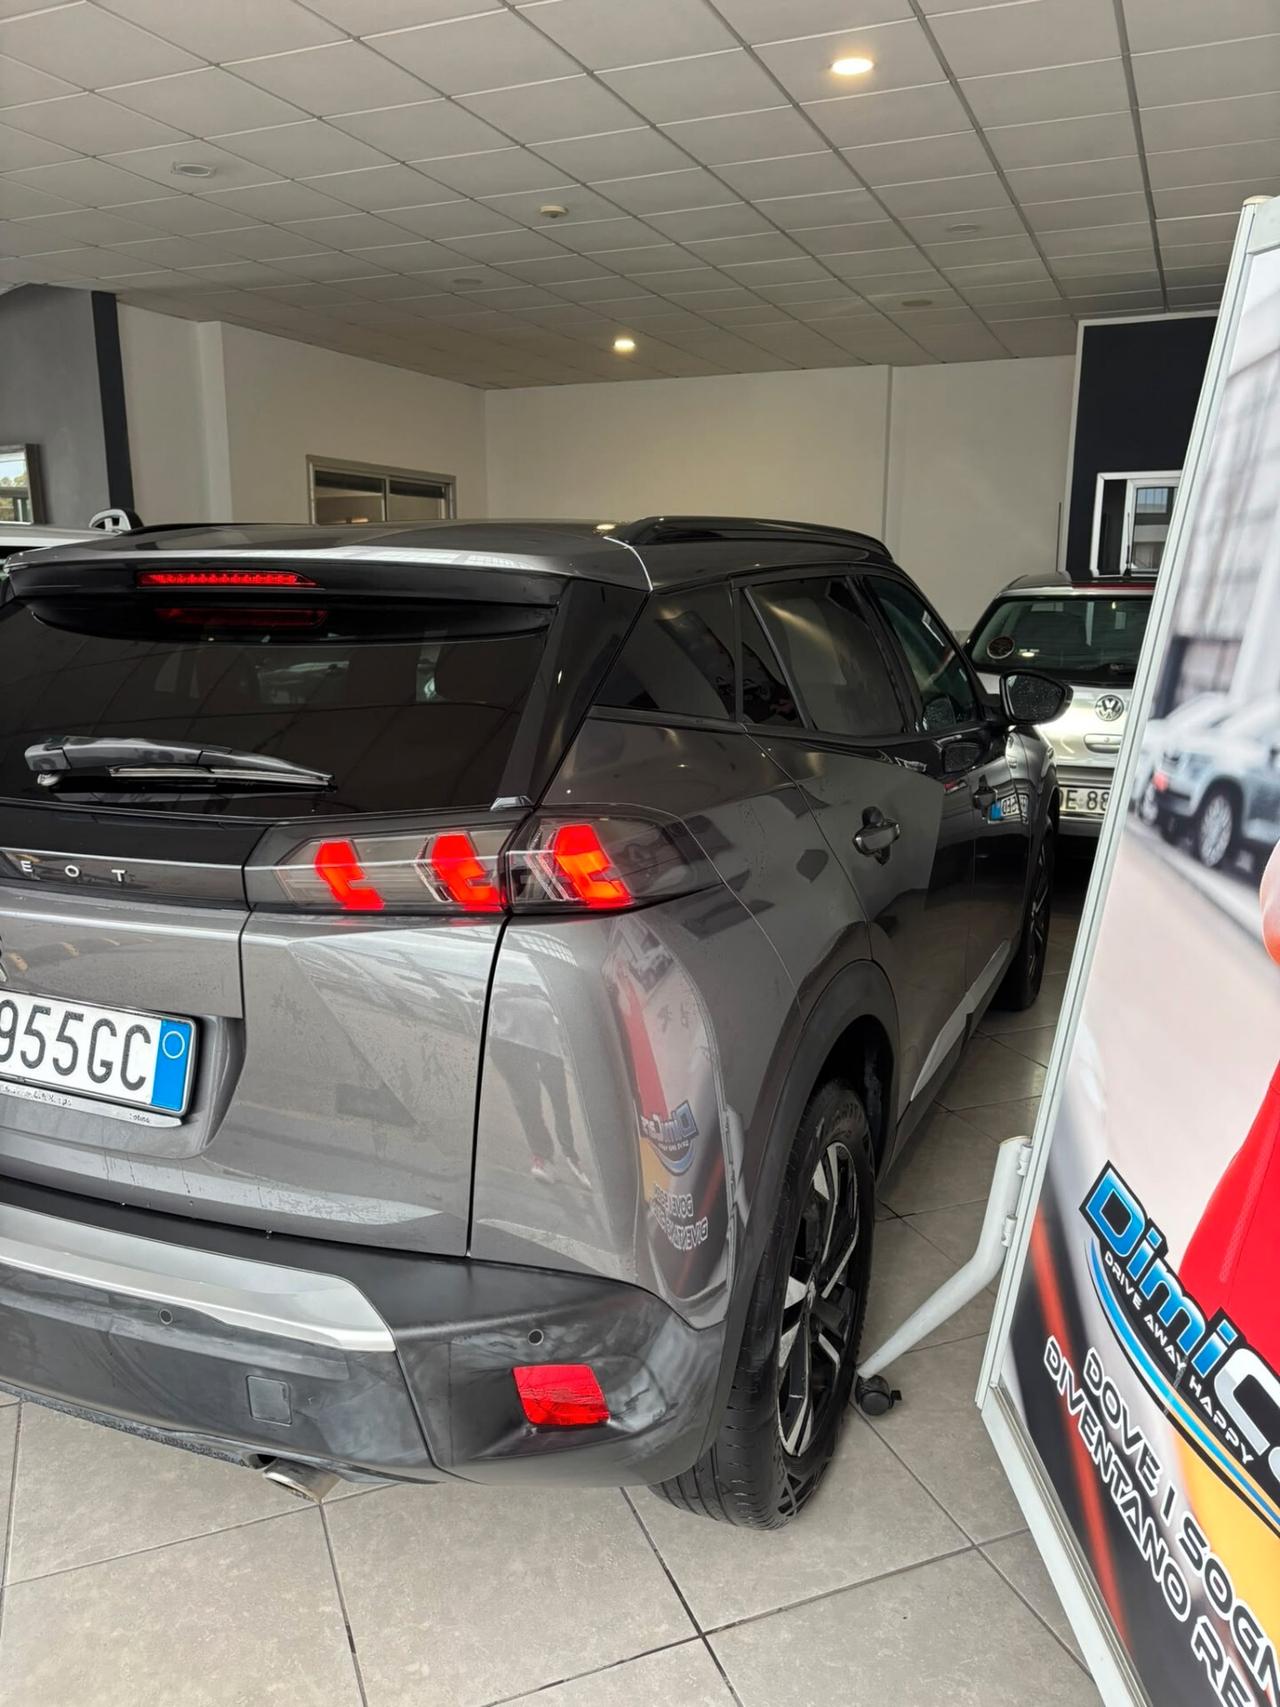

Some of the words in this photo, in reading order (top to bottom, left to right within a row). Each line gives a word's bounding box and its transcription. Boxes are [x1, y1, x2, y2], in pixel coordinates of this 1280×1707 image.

[0, 999, 152, 1091] 955GC
[1079, 1160, 1280, 1484] DimiC
[1104, 1251, 1142, 1311] DRIVE
[1144, 1314, 1187, 1371] AWAY
[1189, 1375, 1254, 1465] HAPPY
[1044, 1336, 1191, 1622] DIVENTANO
[1084, 1347, 1163, 1497] DOVE
[1160, 1481, 1176, 1527] I
